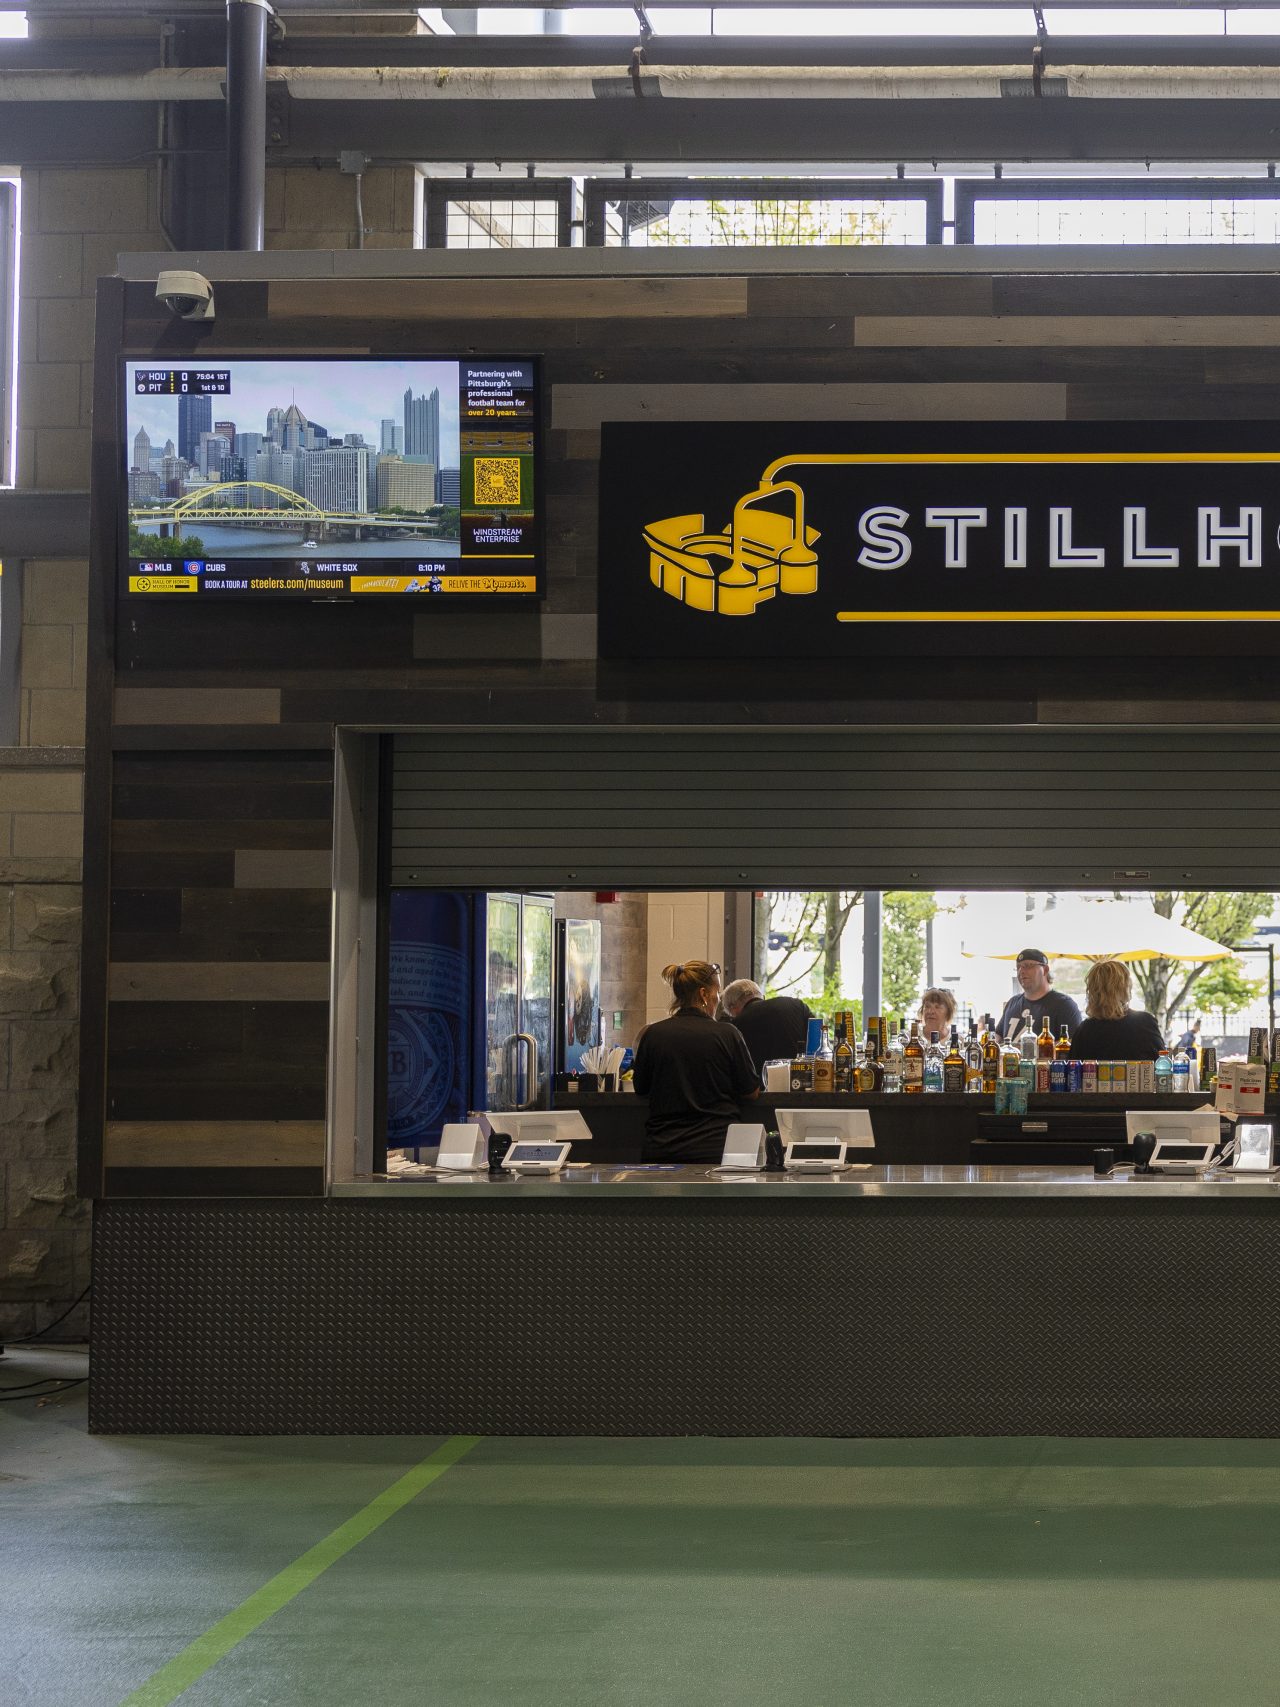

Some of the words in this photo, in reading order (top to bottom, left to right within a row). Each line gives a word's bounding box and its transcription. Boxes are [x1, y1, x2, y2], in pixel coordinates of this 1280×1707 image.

[149, 373, 166, 381] HOU
[182, 372, 188, 381] 0
[149, 384, 162, 392] PIT
[182, 384, 188, 392] 0
[468, 380, 511, 388] Pittsburgh's
[473, 528, 522, 536] WINDSTREAM
[475, 535, 520, 543] ENTERPRISE
[205, 564, 226, 572] CUBS
[317, 564, 341, 572] WHITE
[342, 564, 358, 572] SOX
[418, 564, 432, 572] 8:10
[205, 580, 220, 588] BOOK
[220, 580, 225, 588] A
[225, 580, 240, 588] TOUR
[240, 580, 248, 588] AT
[250, 577, 343, 590] steelers.com/museum
[449, 580, 468, 588] RELIVE
[469, 580, 481, 588] THE
